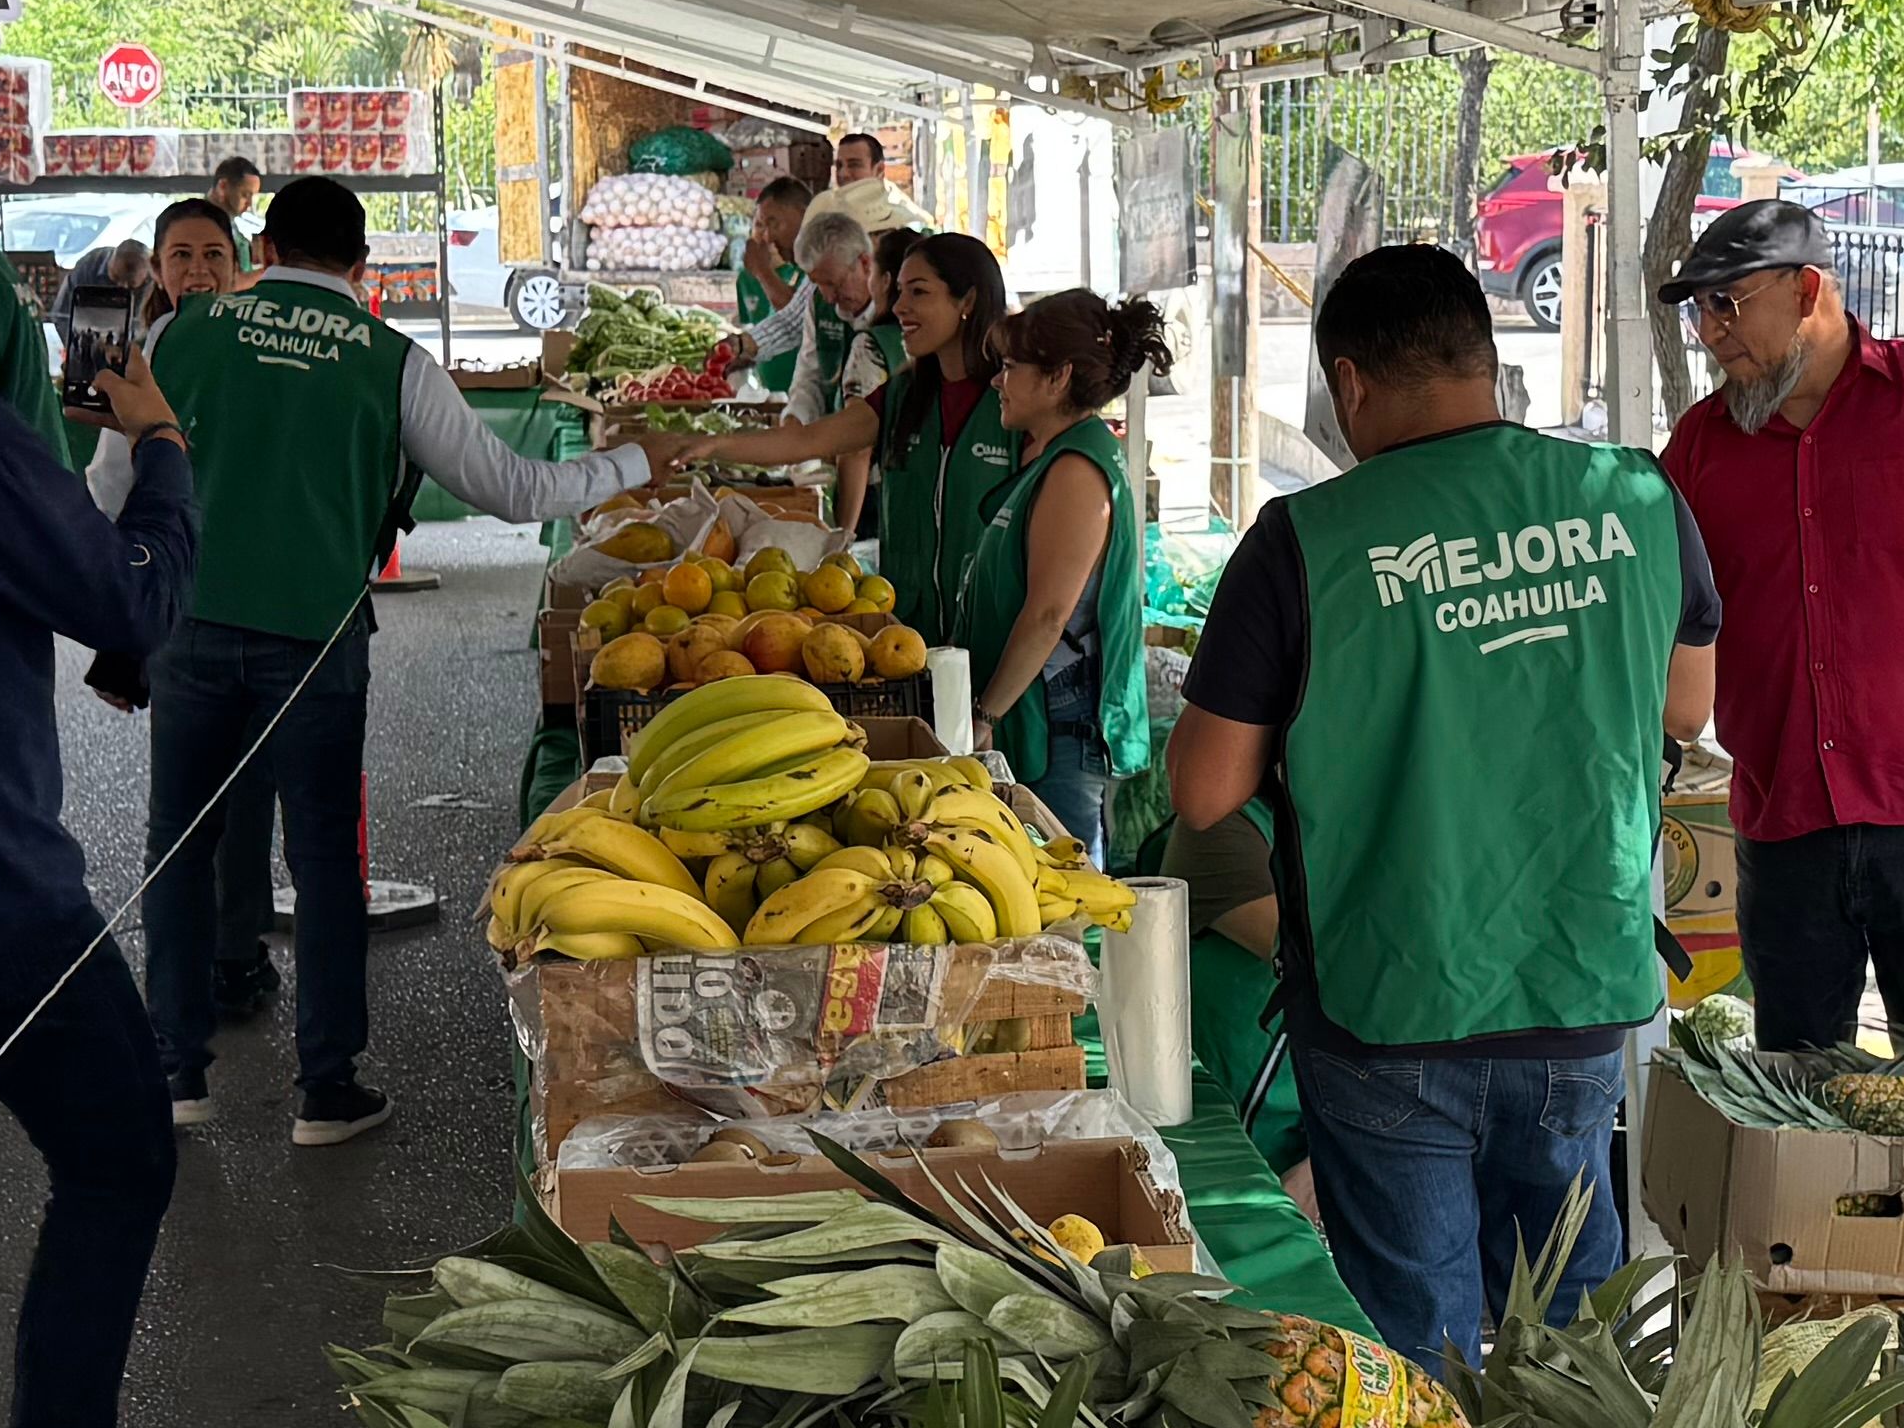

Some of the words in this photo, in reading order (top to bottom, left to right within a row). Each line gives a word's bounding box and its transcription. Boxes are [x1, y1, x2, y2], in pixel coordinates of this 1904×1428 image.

[103, 60, 157, 93] ALTO
[209, 294, 372, 349] MEJORA
[237, 325, 340, 362] COAHUILA
[1366, 511, 1638, 608] MEJORA
[1434, 574, 1608, 633] COAHUILA
